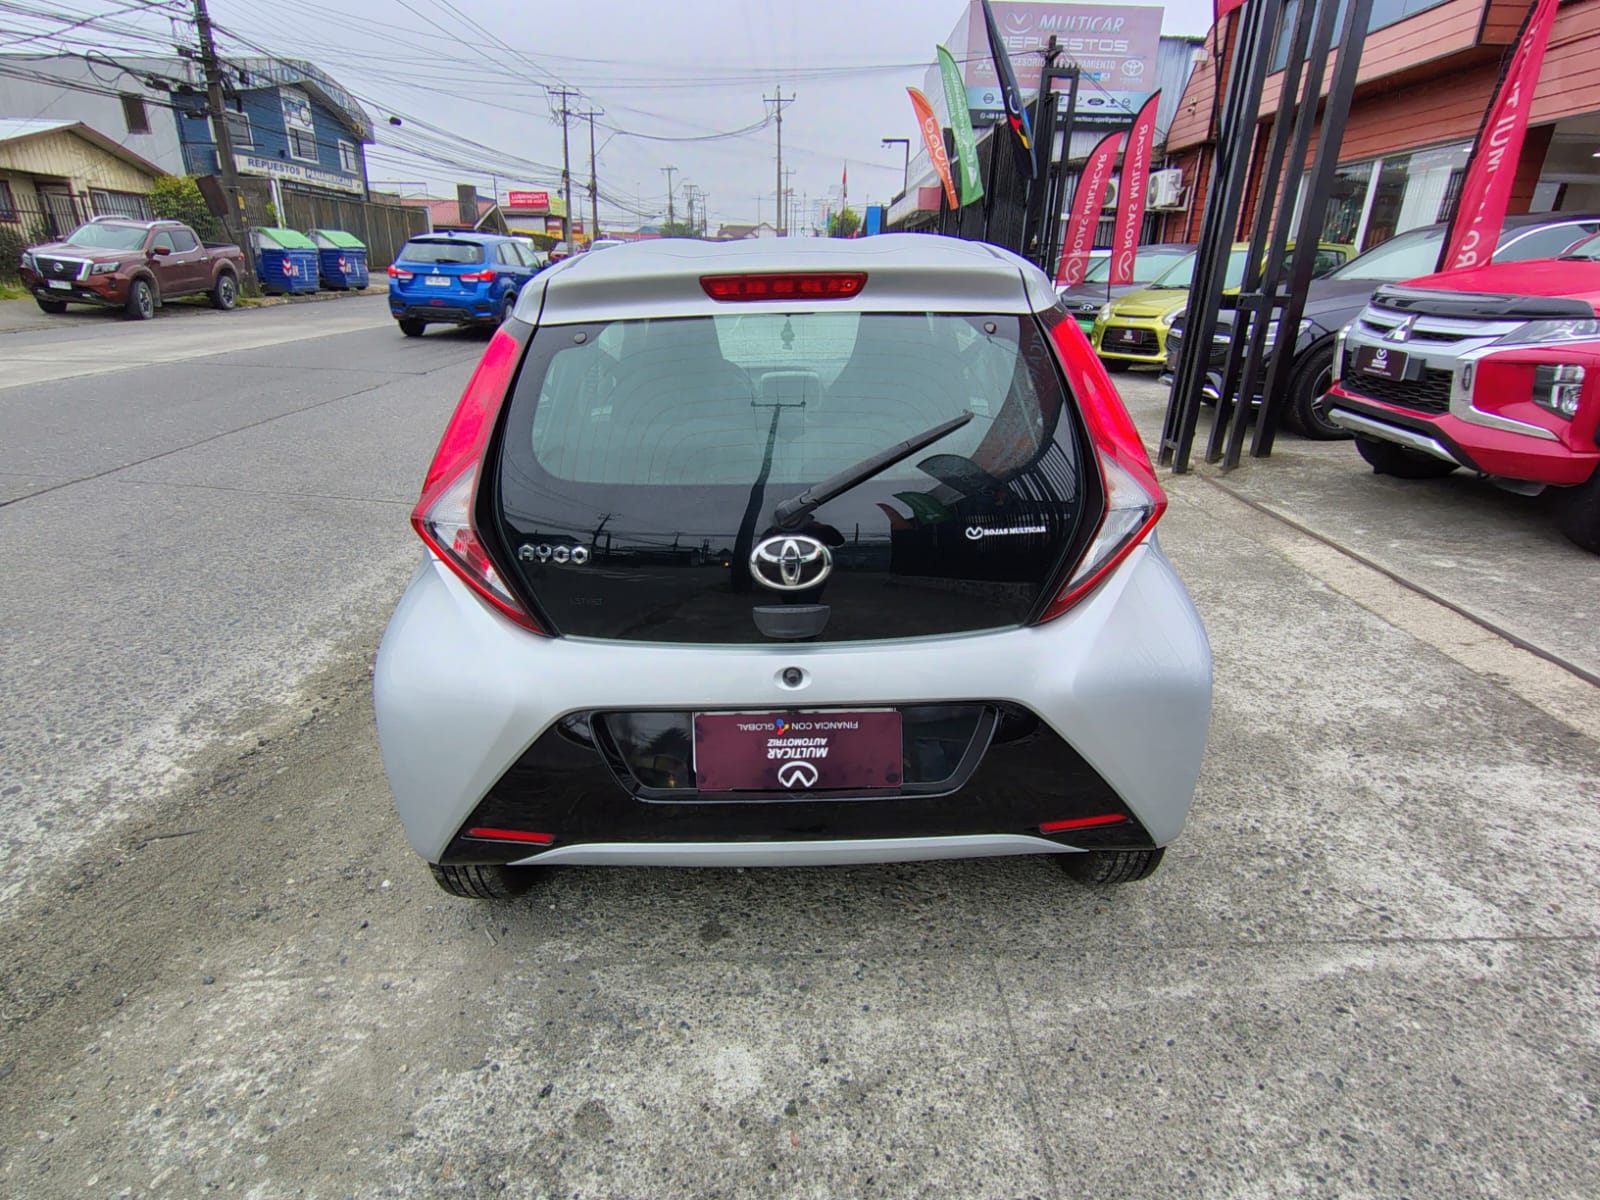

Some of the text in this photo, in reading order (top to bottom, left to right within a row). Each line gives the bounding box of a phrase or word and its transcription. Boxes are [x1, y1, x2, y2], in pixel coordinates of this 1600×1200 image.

[1038, 15, 1125, 33] MULTICAR
[247, 158, 300, 175] REPUESTOS
[983, 525, 1046, 536] ROJAS MULTICAR
[518, 544, 588, 564] AYGO
[737, 721, 858, 731] FINANCIA CON GLOBAL
[767, 737, 828, 747] AUTOMOTRIZ
[767, 747, 829, 759] MULTICAR
